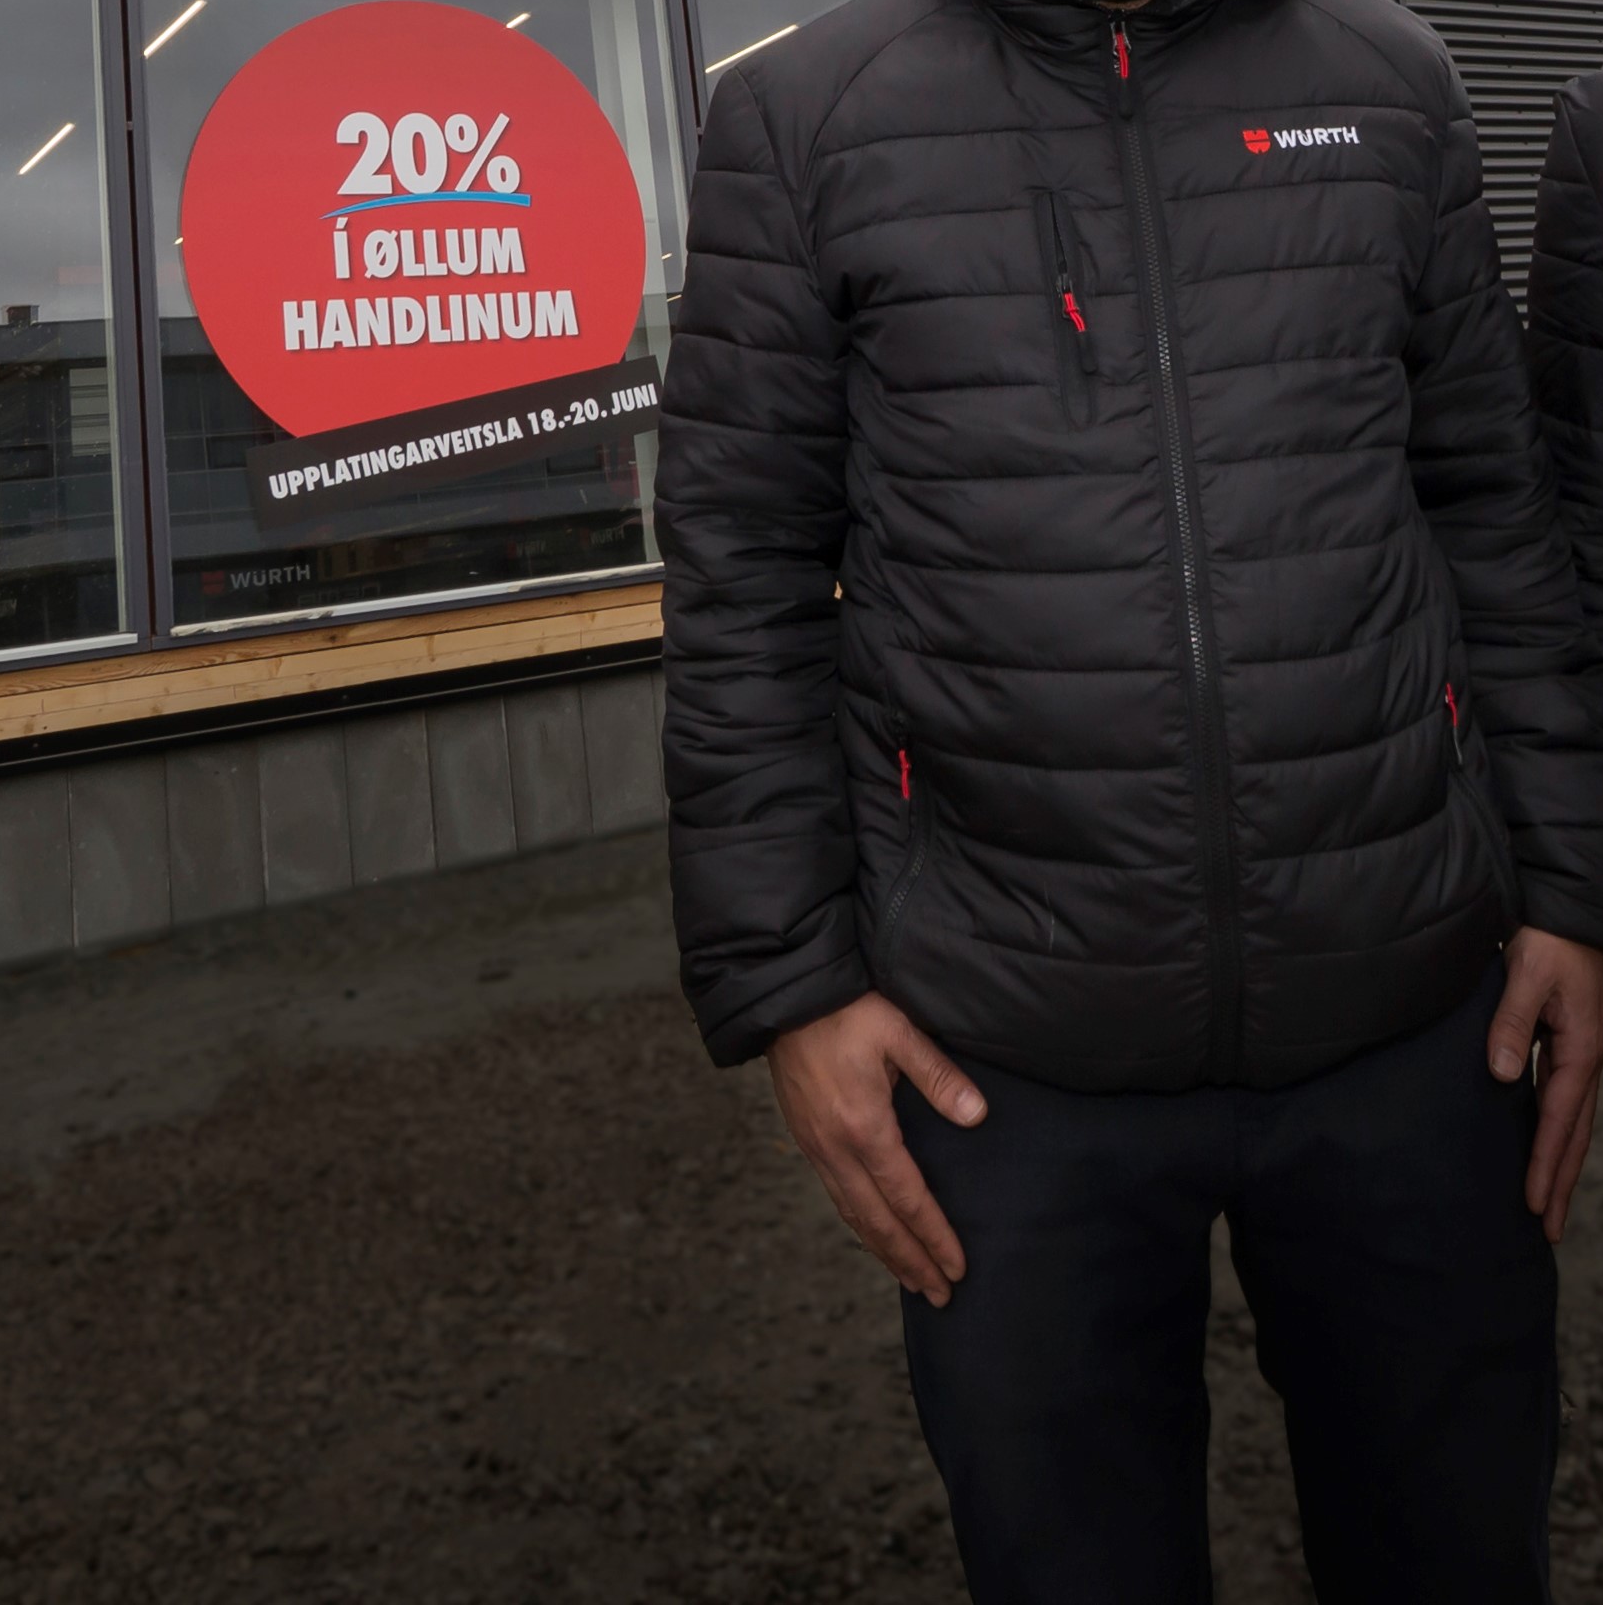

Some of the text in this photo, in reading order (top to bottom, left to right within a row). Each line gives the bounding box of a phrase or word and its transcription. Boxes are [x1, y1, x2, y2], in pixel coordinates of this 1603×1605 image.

[336, 111, 521, 195] 20%
[333, 216, 526, 279] Í ØLLUM
[282, 289, 580, 351] HANDLINUM
[268, 383, 658, 500] UPPLATINGARVEITSLA 18.-20. JUNI
[230, 564, 311, 590] WÜRTH
